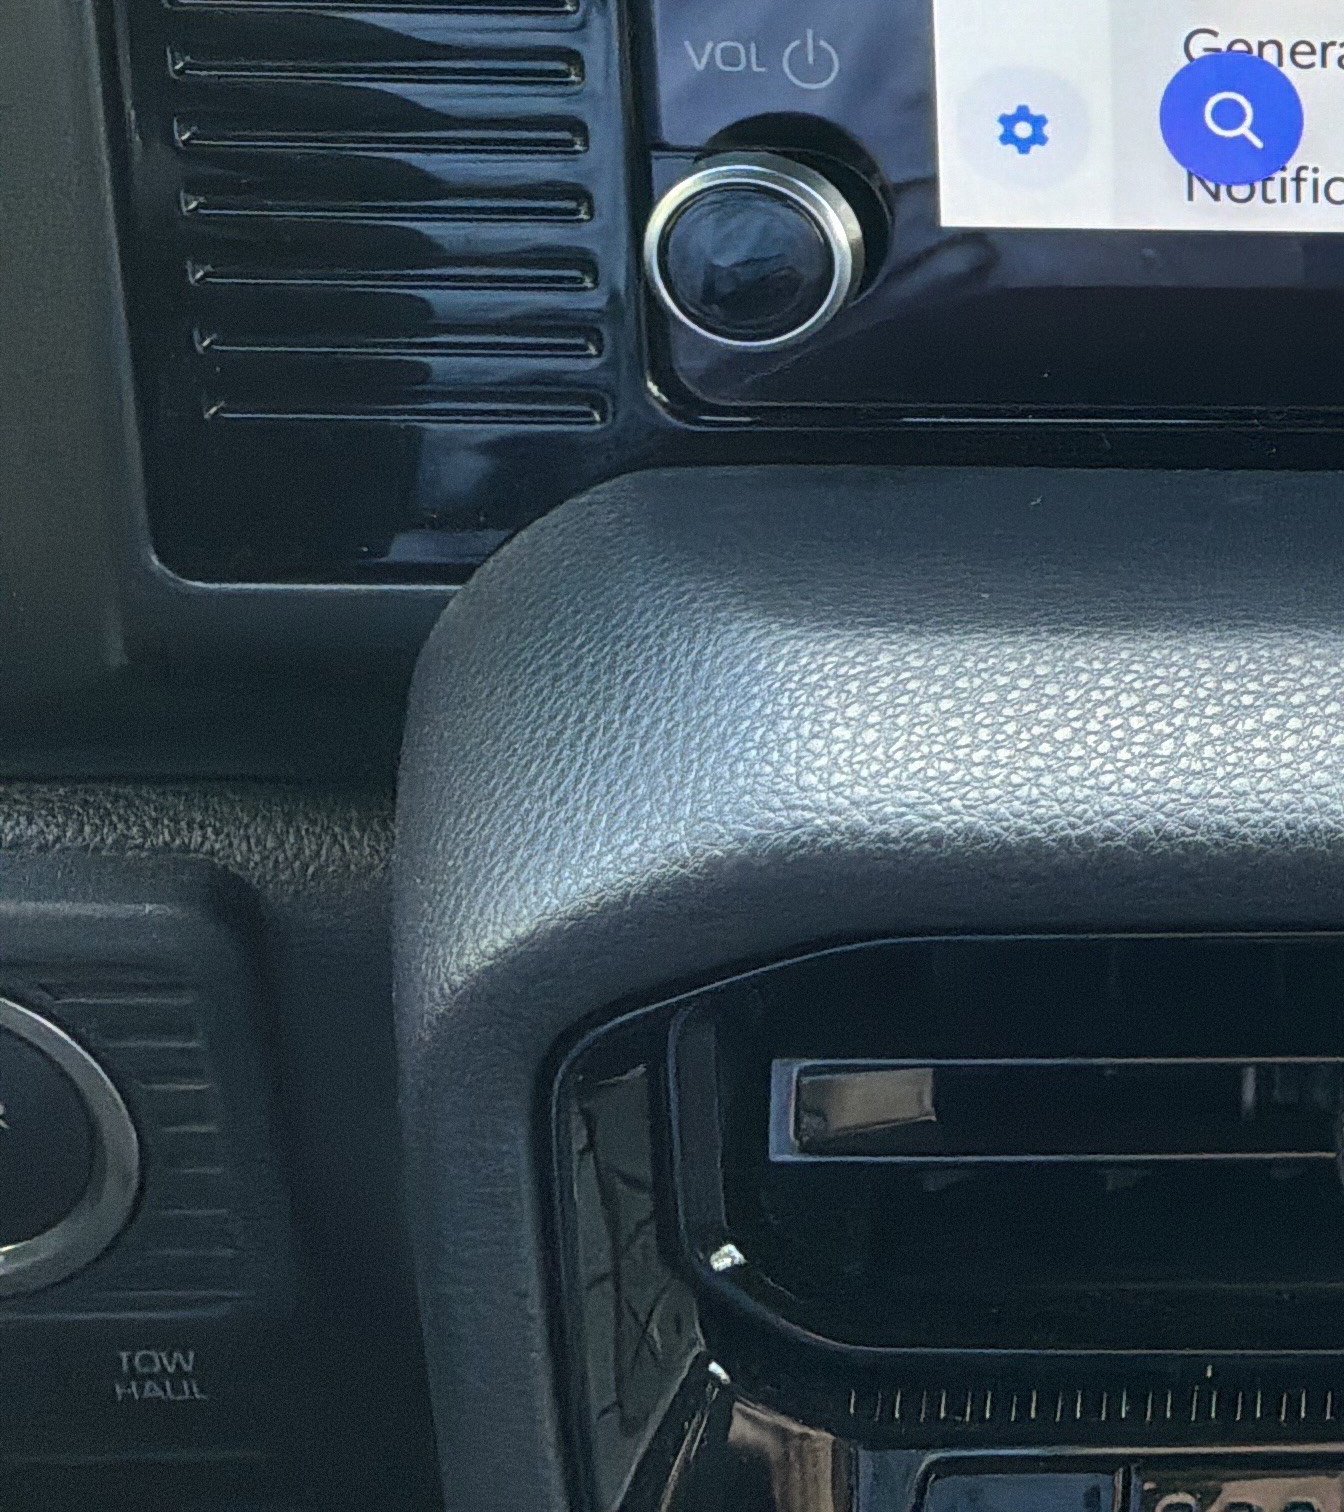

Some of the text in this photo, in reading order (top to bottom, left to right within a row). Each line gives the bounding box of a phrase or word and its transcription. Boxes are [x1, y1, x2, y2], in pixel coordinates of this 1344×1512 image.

[685, 41, 765, 71] VOL
[119, 1349, 196, 1374] TOW
[115, 1378, 208, 1402] HAUL
